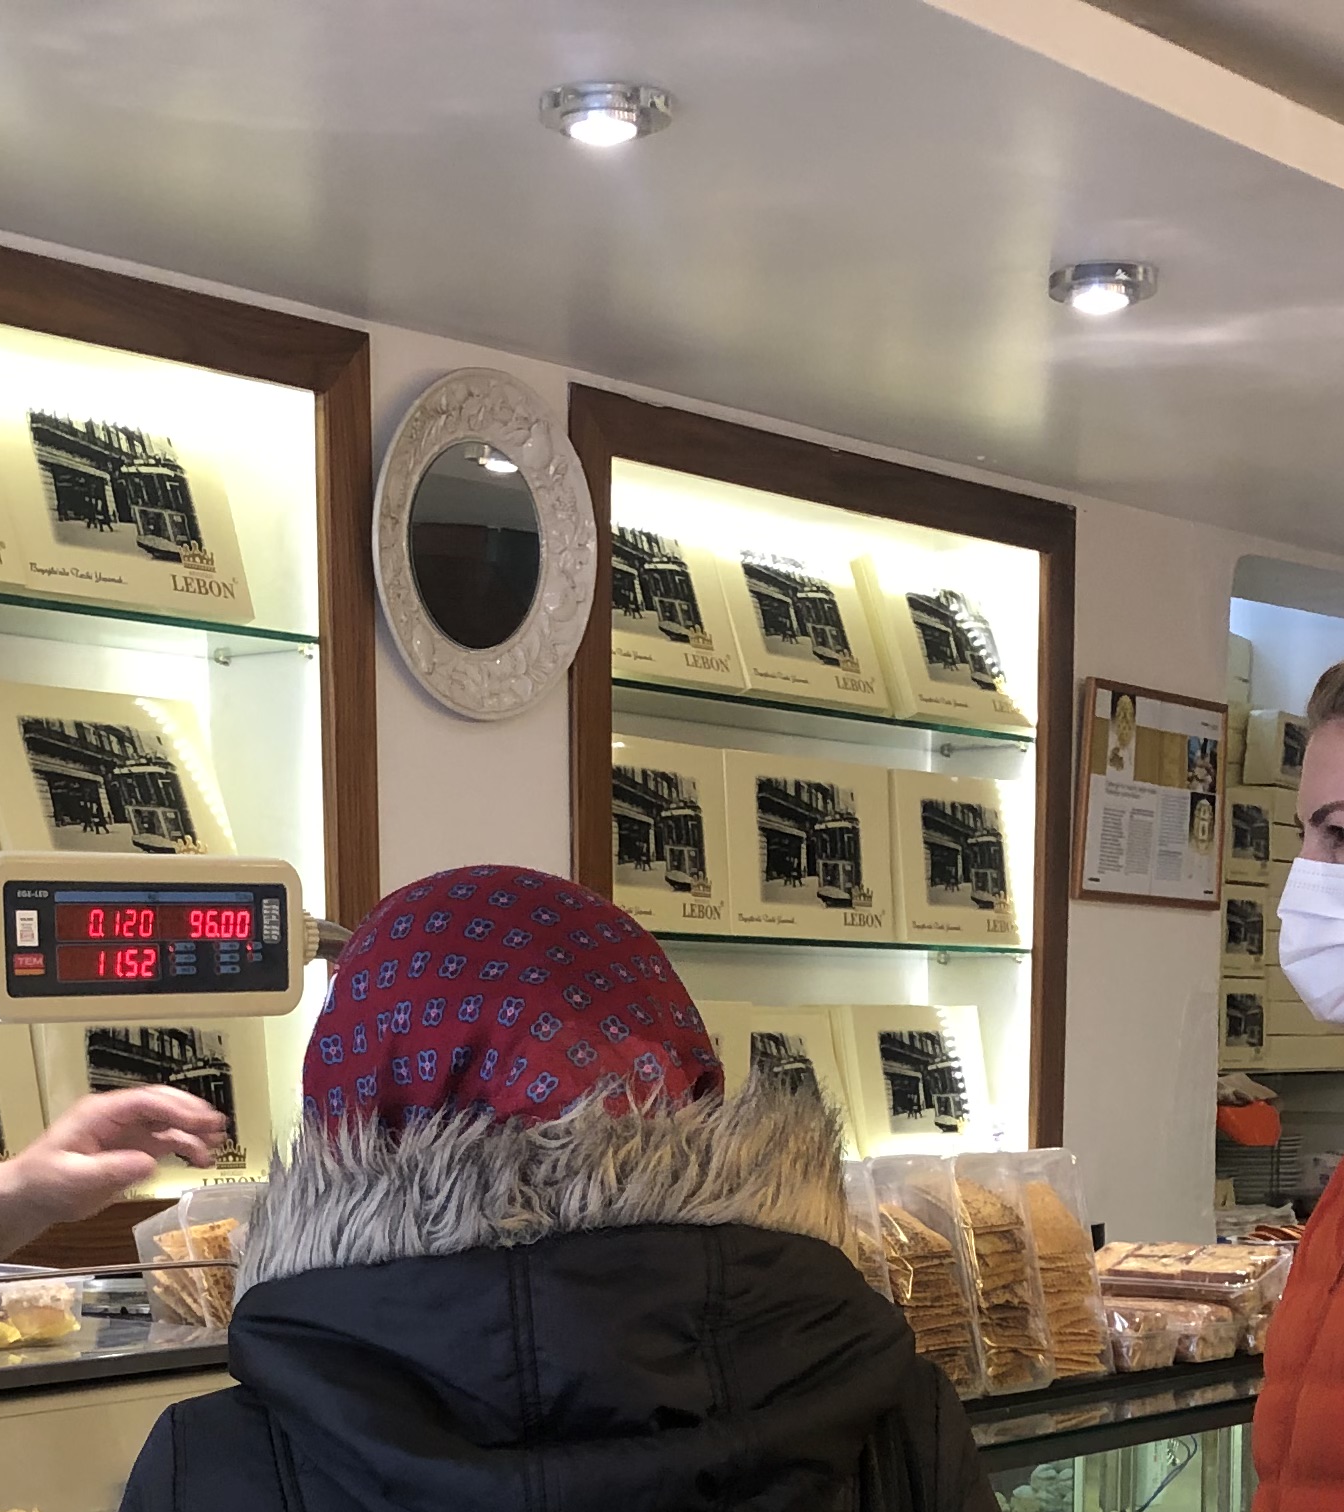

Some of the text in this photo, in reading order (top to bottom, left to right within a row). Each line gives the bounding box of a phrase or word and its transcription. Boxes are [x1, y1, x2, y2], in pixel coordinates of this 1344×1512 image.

[170, 574, 236, 599] LEBON
[683, 652, 731, 673] LEBON
[835, 675, 875, 694] LEBON
[682, 902, 721, 920] LEBON
[843, 911, 882, 928] LEBON
[189, 909, 251, 938] 96.00
[17, 956, 44, 966] TEM
[97, 948, 157, 978] 11.52
